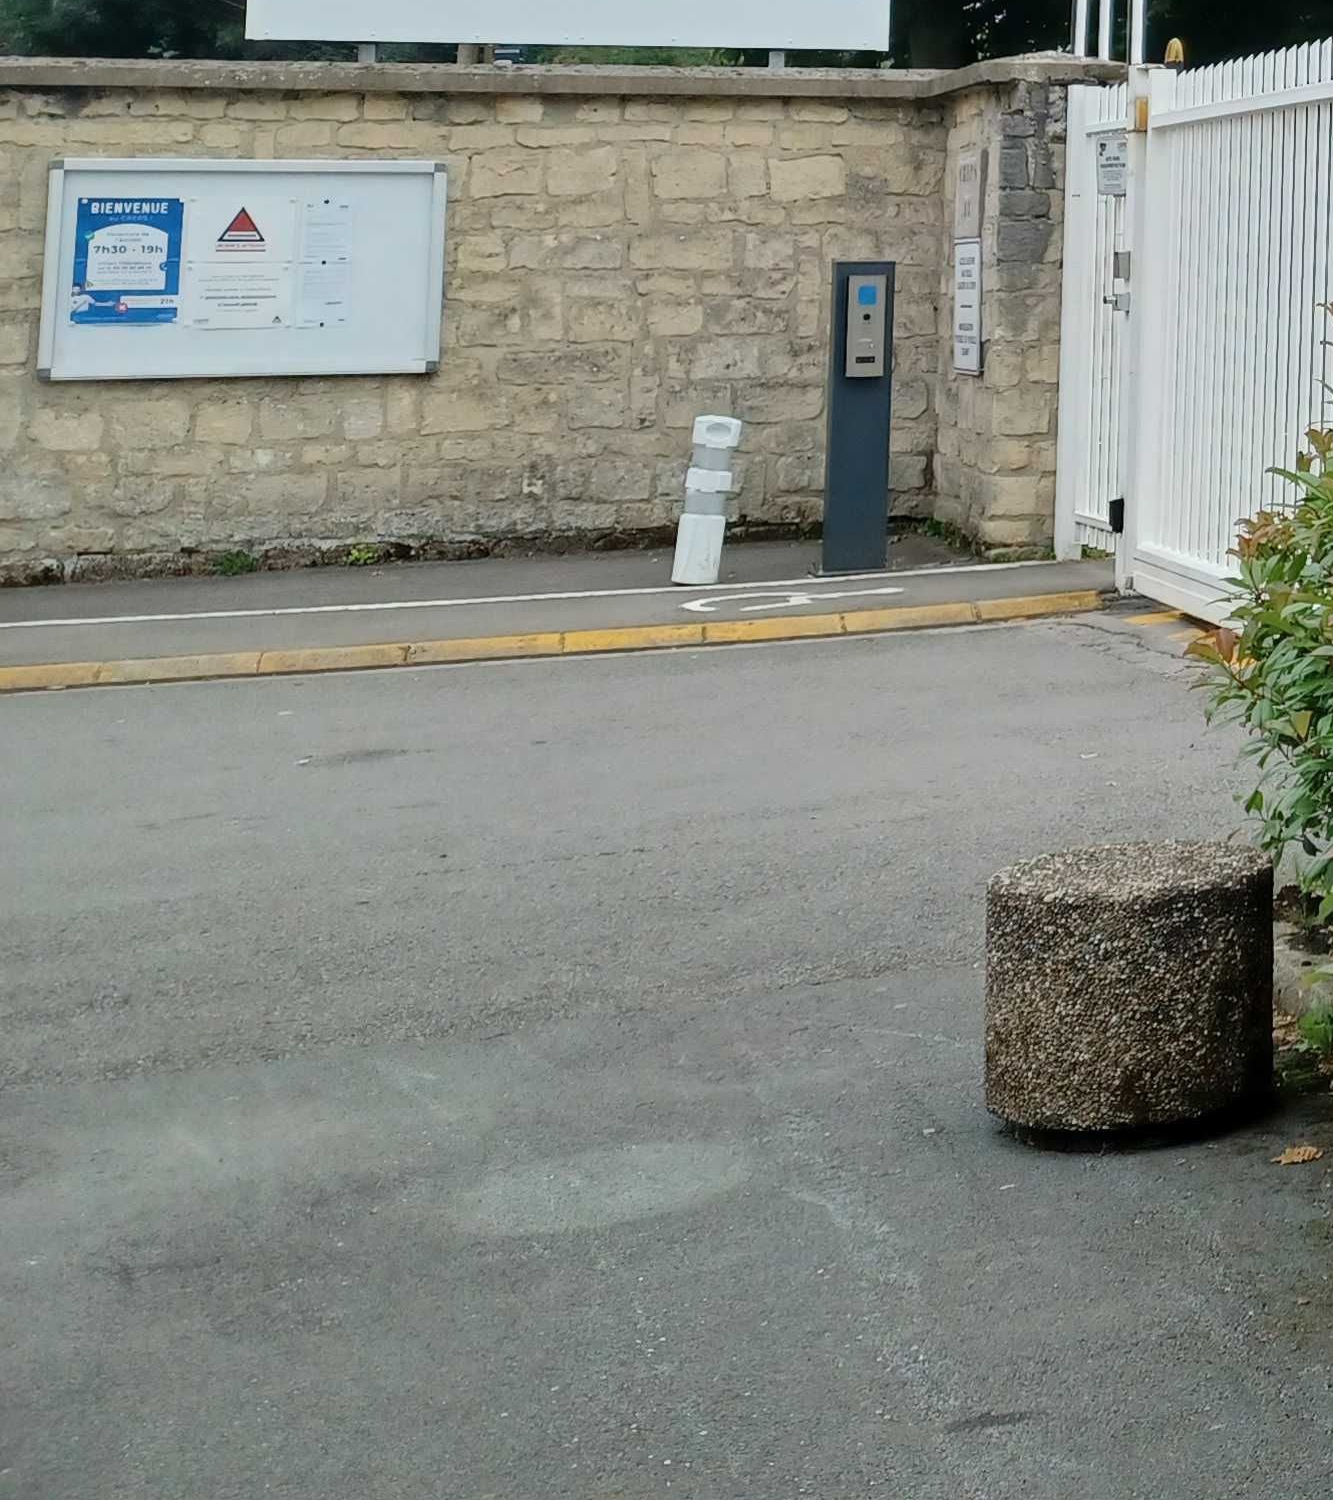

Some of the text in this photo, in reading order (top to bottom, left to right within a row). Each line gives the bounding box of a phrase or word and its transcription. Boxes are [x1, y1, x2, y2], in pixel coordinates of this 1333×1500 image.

[91, 202, 169, 214] BIENVENUE
[93, 245, 128, 254] 7h30
[141, 245, 164, 254] 19h
